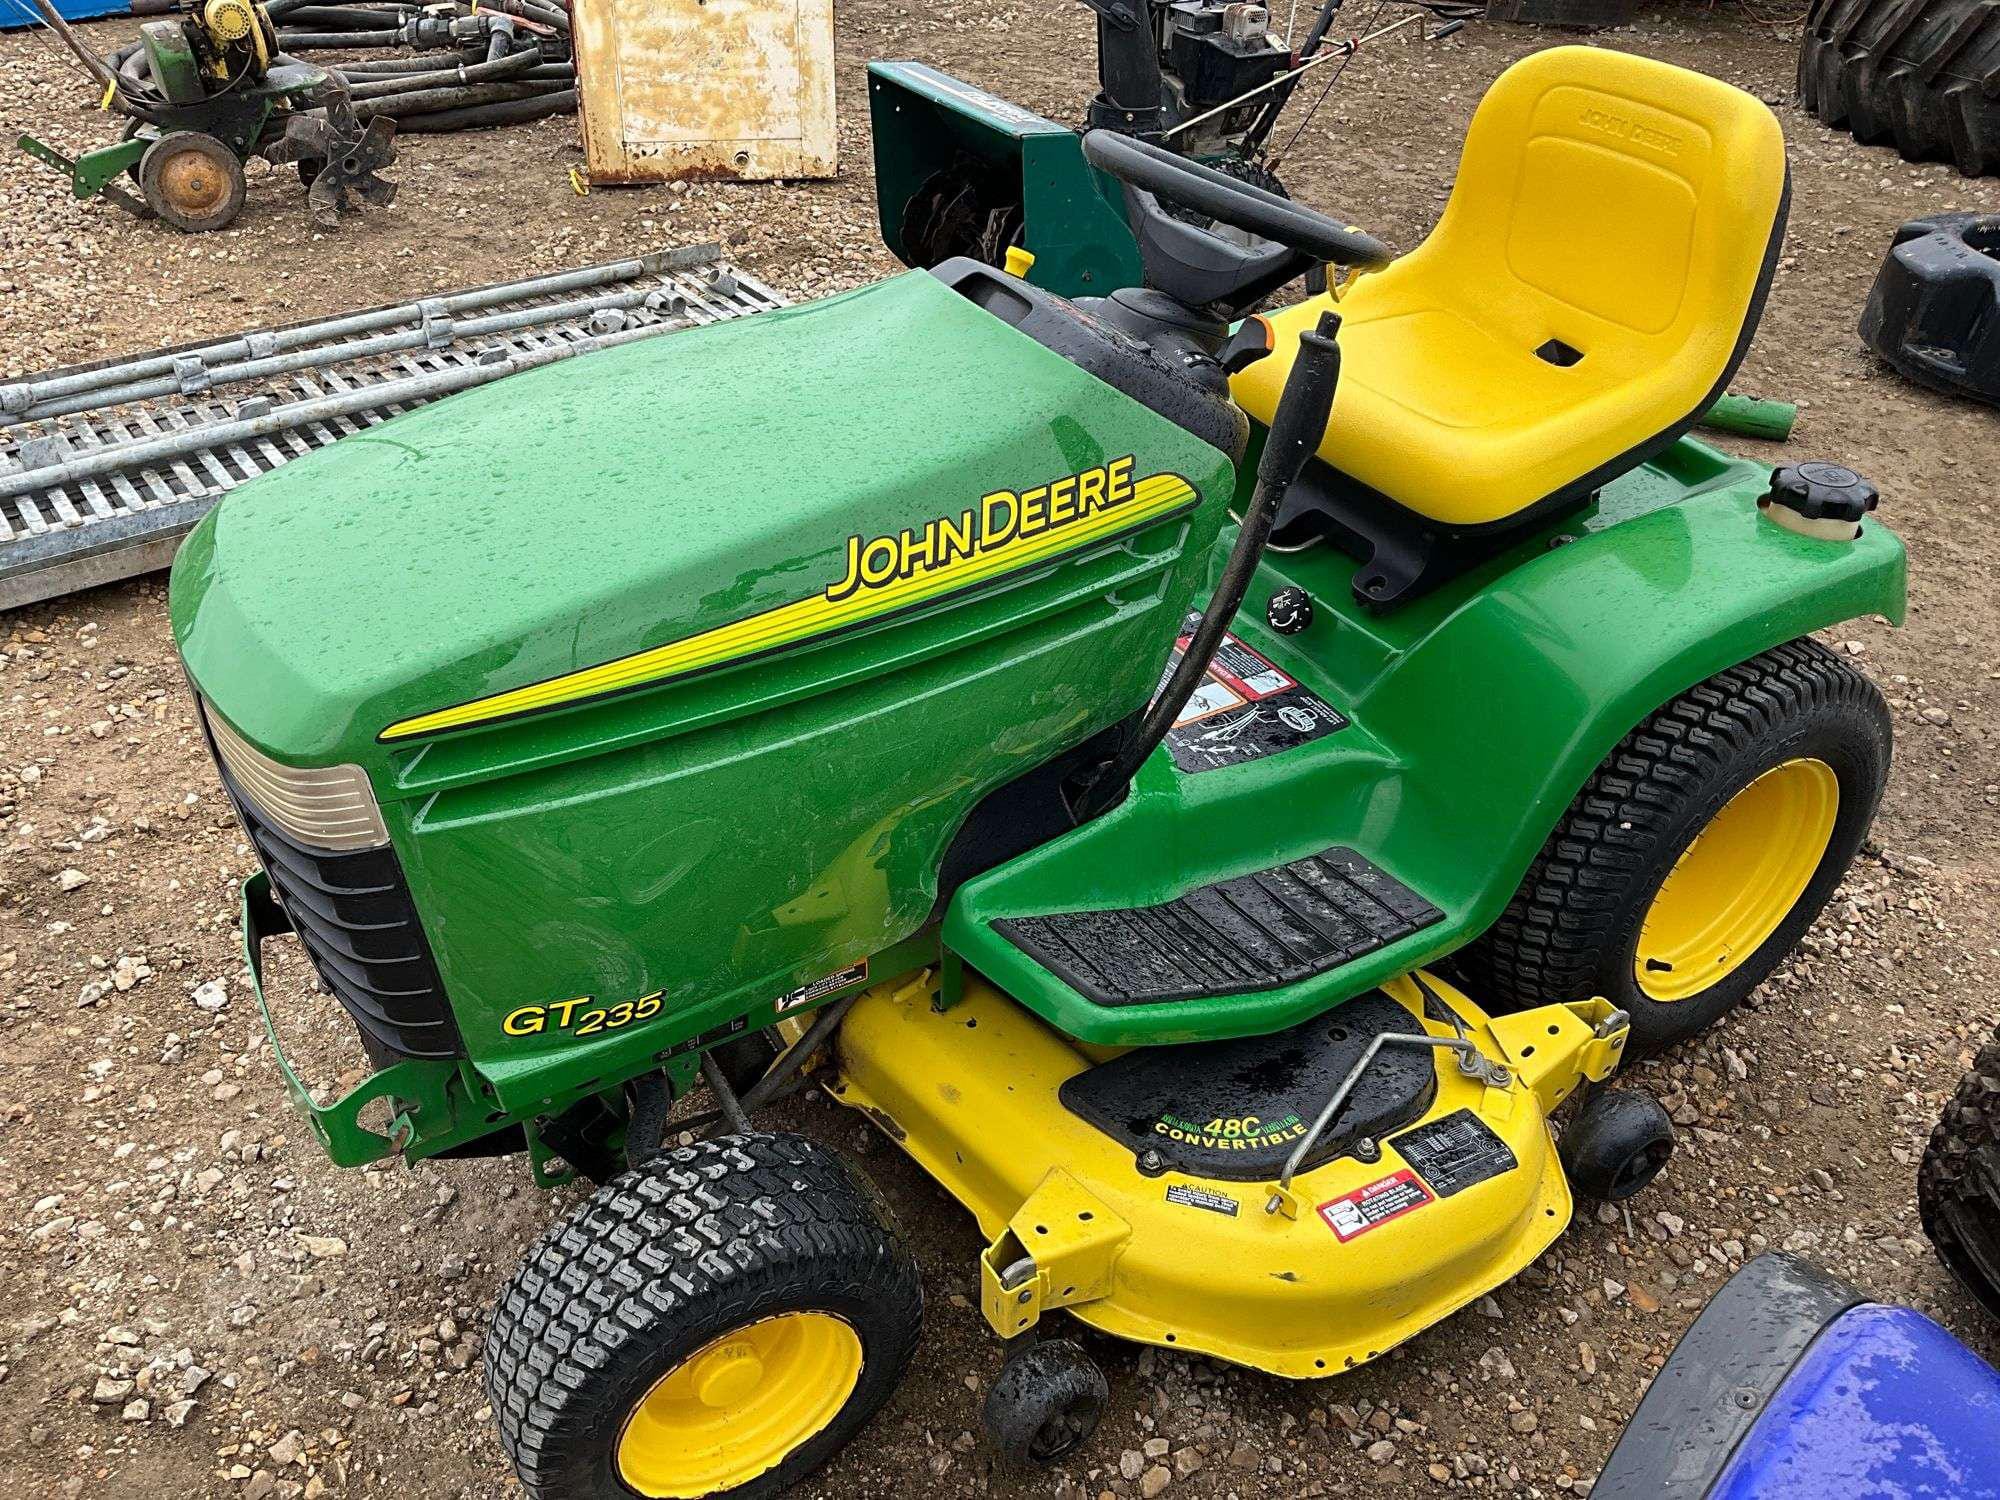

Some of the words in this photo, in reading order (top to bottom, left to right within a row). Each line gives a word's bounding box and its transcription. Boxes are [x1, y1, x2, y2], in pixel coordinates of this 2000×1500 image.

[1580, 108, 1627, 138] JOHN
[1630, 124, 1682, 156] DEERE
[826, 508, 974, 600] JOHN
[980, 454, 1134, 550] DEERE
[1154, 1122, 1308, 1150] CONVERTIBLE
[1203, 1115, 1261, 1138] 48C
[1188, 1183, 1229, 1198] CAUTION
[1367, 1176, 1399, 1194] DANGER
